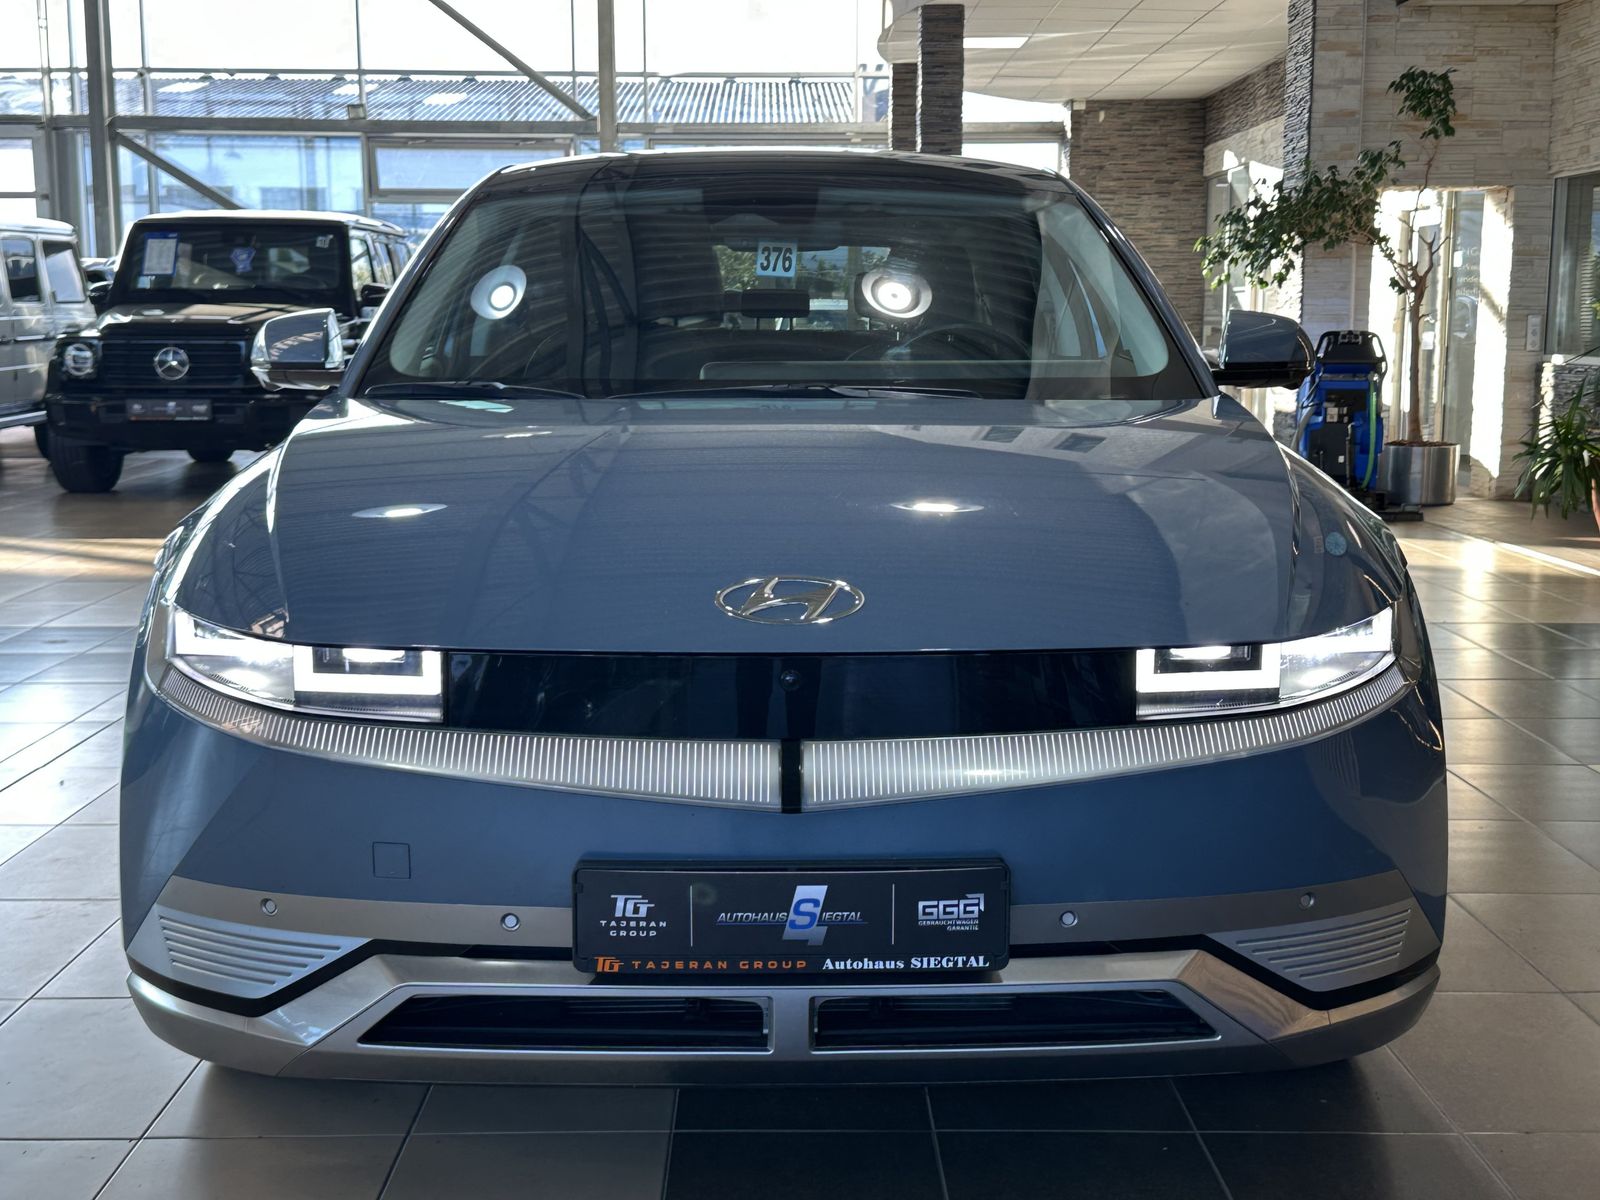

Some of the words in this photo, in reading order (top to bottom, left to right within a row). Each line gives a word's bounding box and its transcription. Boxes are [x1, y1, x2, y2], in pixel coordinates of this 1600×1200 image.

[760, 246, 793, 272] 376
[717, 912, 788, 923] AUTOHAUS
[600, 920, 667, 928] TAJERAN
[632, 960, 729, 970] TAJERAN
[739, 960, 807, 970] GROUP
[822, 957, 905, 970] Autohaus
[910, 956, 990, 969] SIEGTAL
